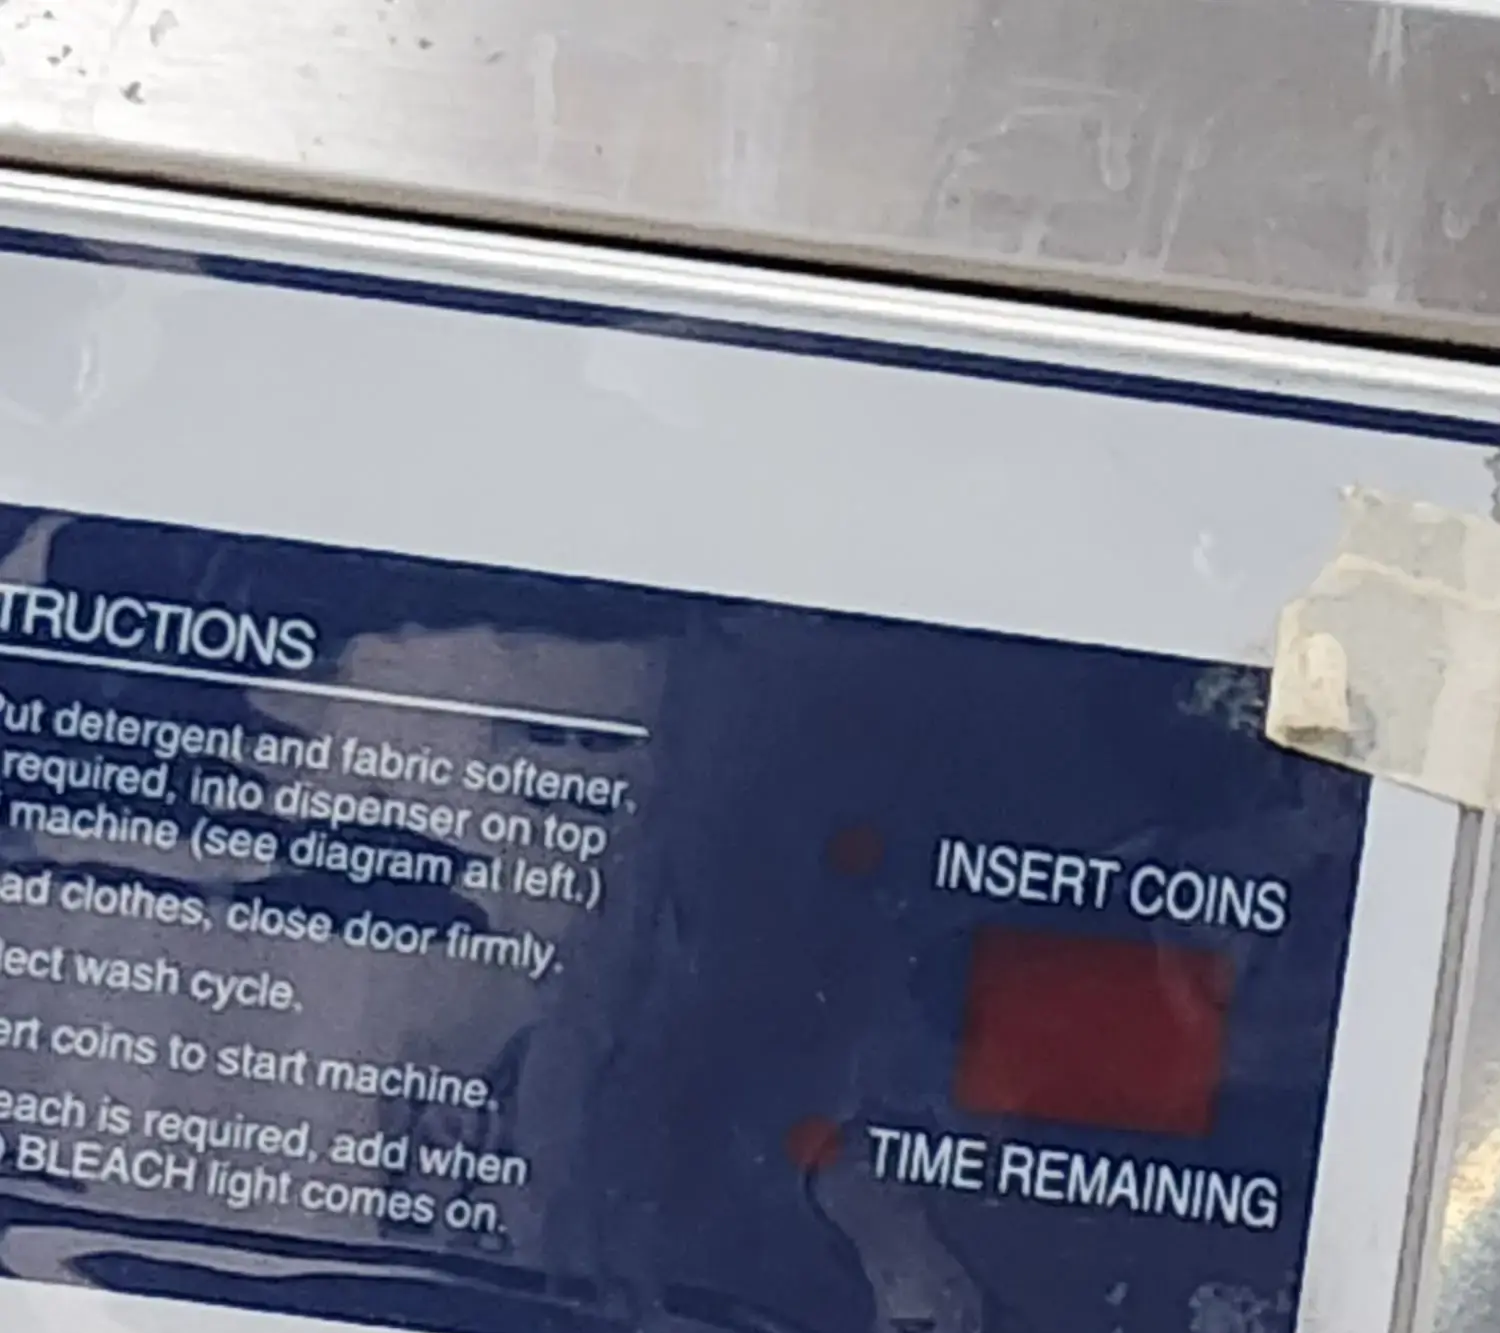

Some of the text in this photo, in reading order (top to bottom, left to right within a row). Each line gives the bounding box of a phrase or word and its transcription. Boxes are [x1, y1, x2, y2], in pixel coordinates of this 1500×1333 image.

[0, 692, 45, 735] ut
[53, 700, 244, 760] detergent
[254, 732, 330, 771] and
[342, 738, 453, 787] fabric
[3, 750, 176, 805] required,
[191, 767, 264, 811] into
[273, 777, 471, 840] dispenser
[481, 812, 530, 846] on
[544, 818, 607, 861] top
[10, 799, 603, 910] machine (see diagram at left.)
[61, 880, 213, 931] clothes,
[226, 900, 331, 942] close
[344, 913, 437, 954] door
[447, 920, 563, 981] firmly.
[935, 838, 1288, 932] INSERT COINS
[74, 950, 180, 996] wash
[190, 968, 303, 1015] cycle.
[51, 1021, 157, 1067] coins
[168, 1033, 207, 1073] to
[218, 1043, 307, 1087] start
[317, 1054, 499, 1112] machine.
[17, 1132, 198, 1192] BLEACH
[208, 1155, 291, 1211] light
[301, 1178, 435, 1225] comes
[446, 1199, 507, 1235] on.
[98, 1097, 132, 1136] is
[143, 1110, 318, 1165] required,
[331, 1130, 409, 1171] add
[418, 1144, 527, 1188] when
[868, 1125, 1280, 1229] TIME REMAINING
